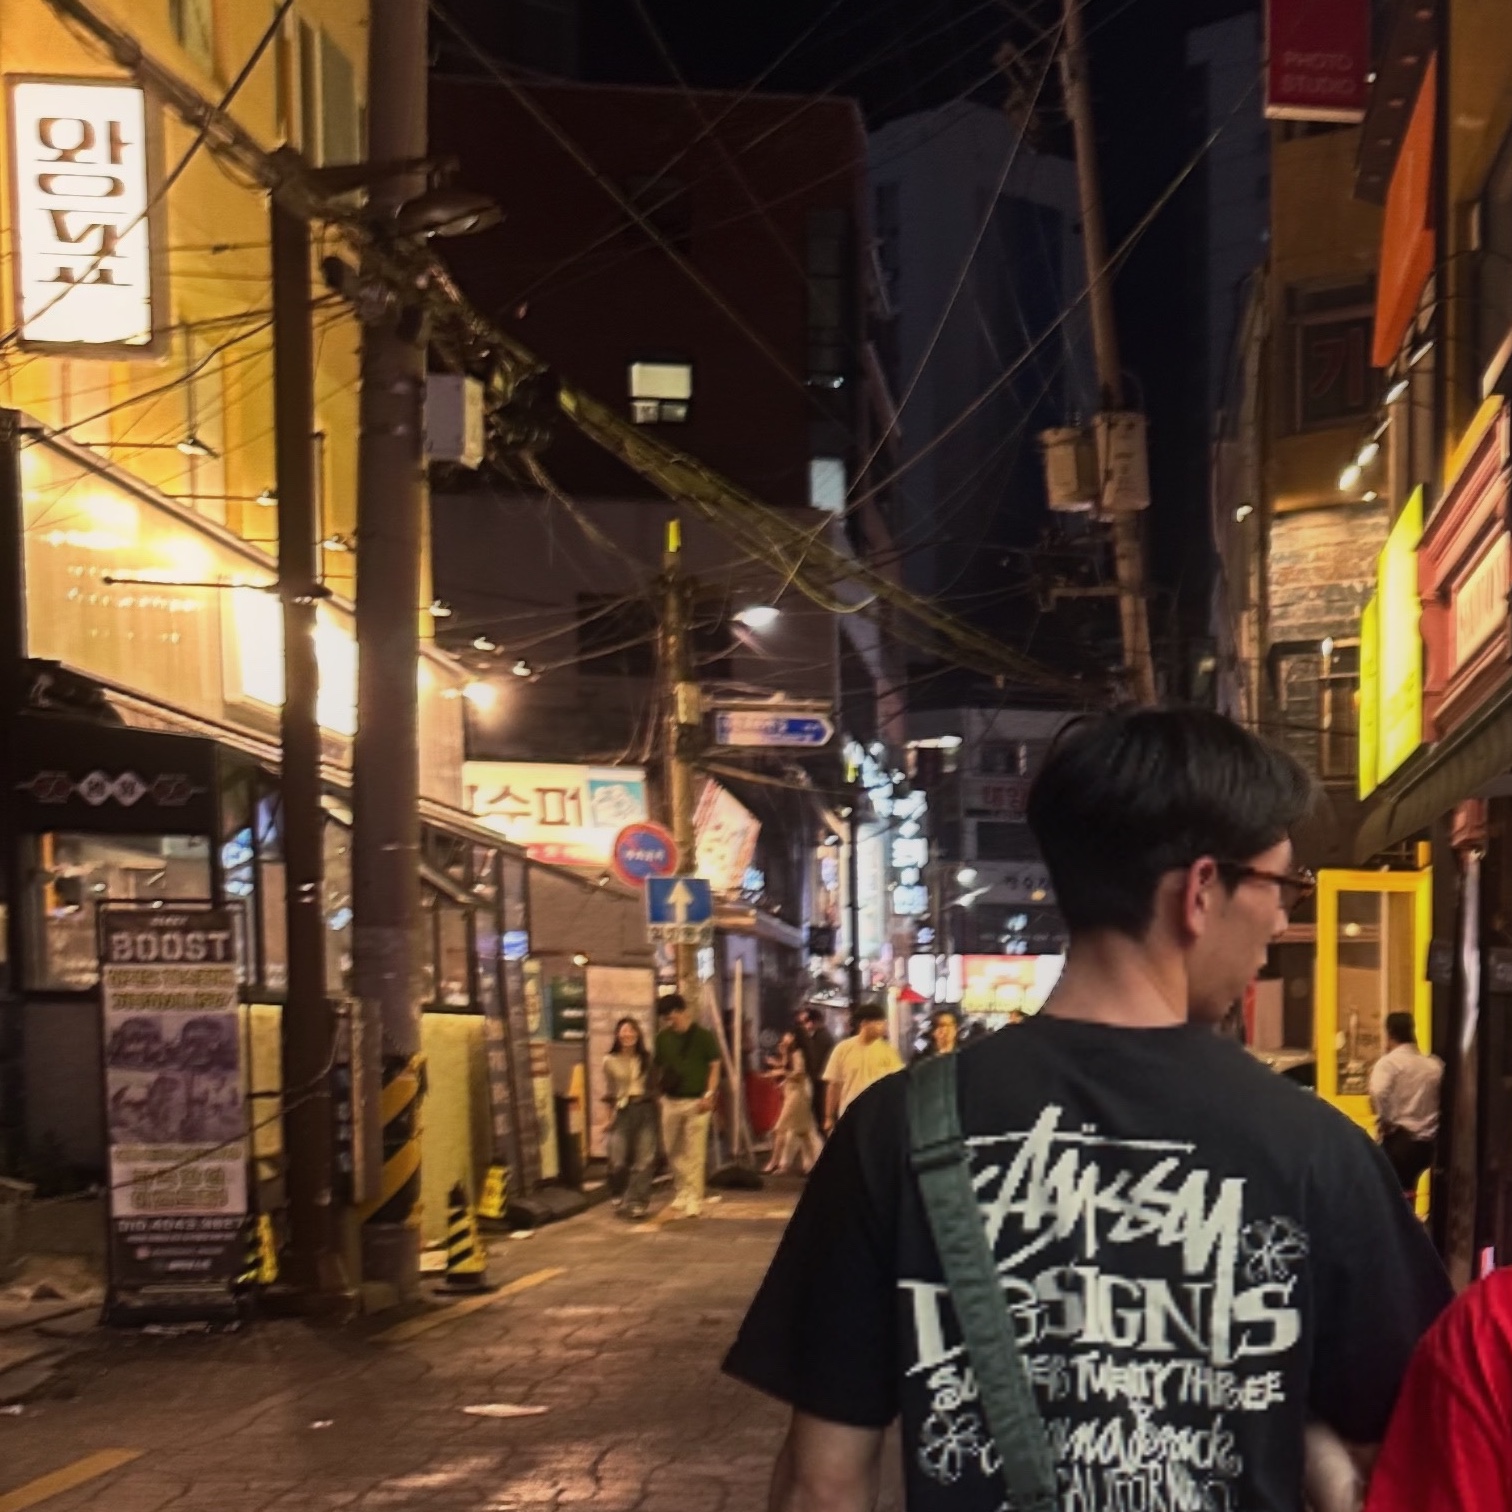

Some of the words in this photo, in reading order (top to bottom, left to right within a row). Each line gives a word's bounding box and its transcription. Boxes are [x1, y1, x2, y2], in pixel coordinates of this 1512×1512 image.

[1281, 51, 1354, 71] PHOTO
[1280, 74, 1357, 95] STUDIO
[112, 931, 230, 961] BOOST
